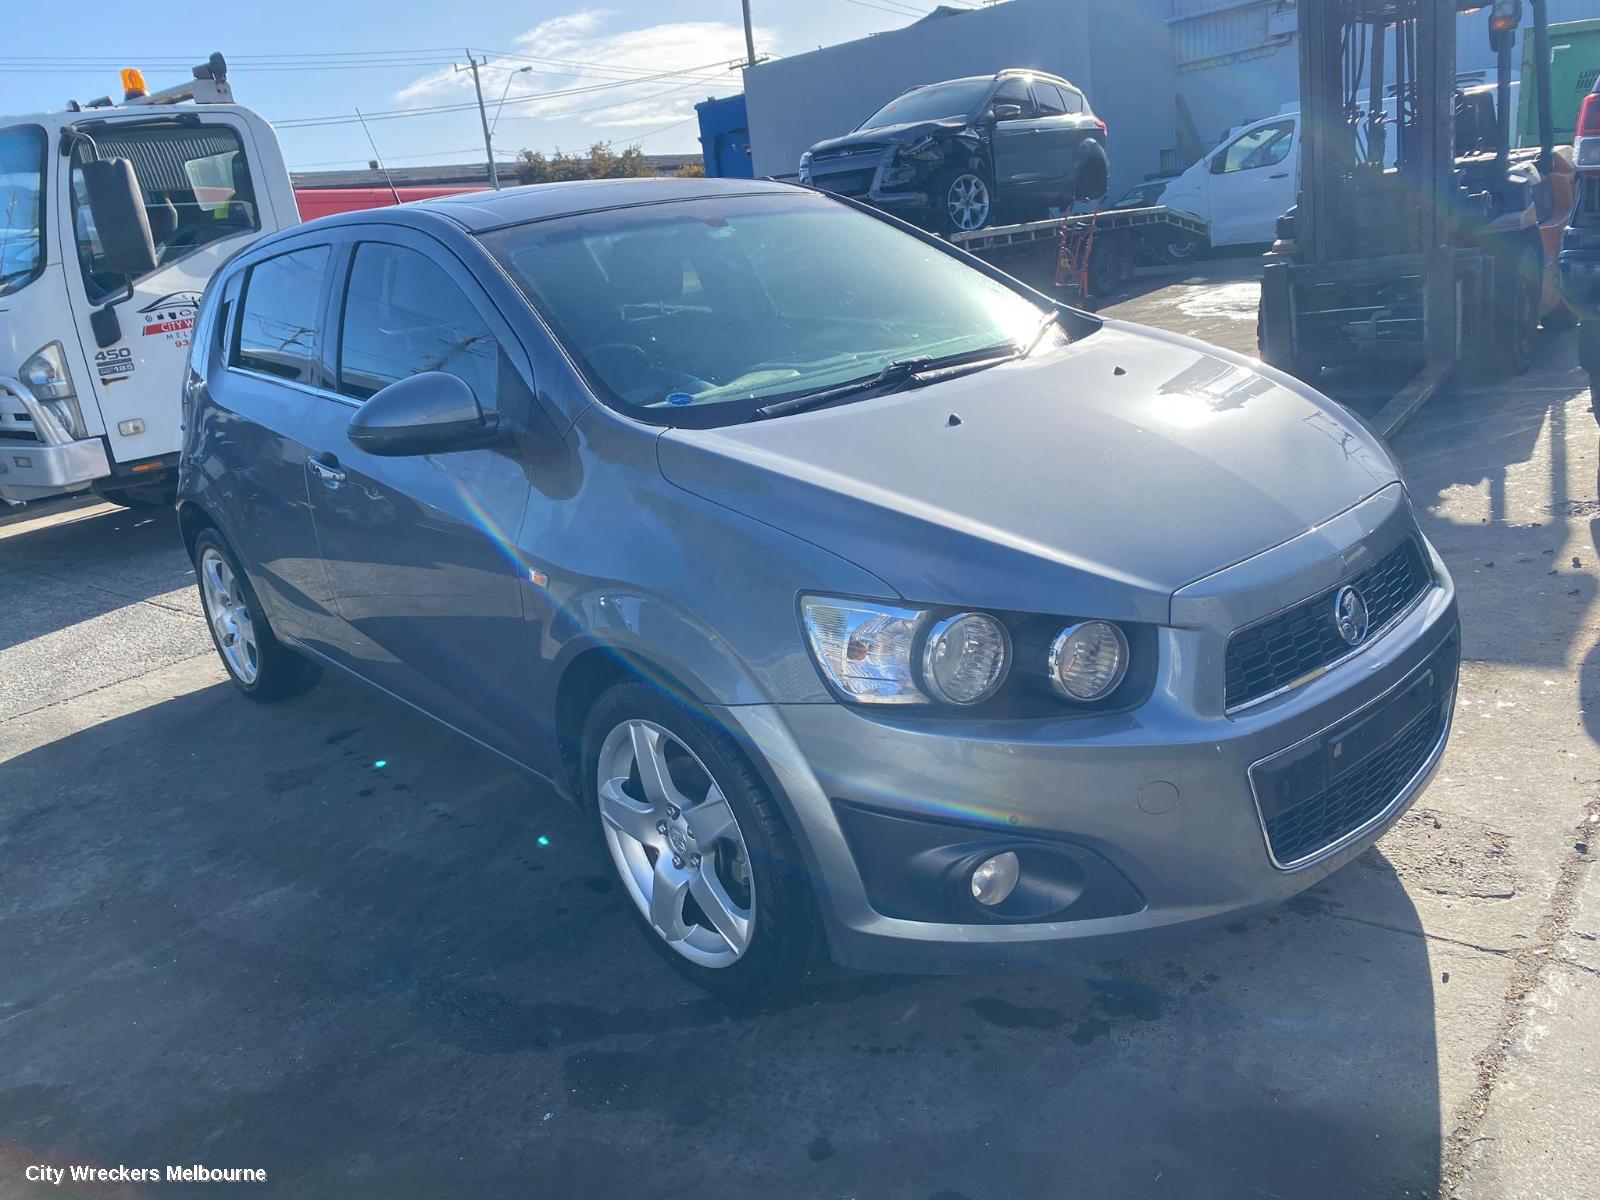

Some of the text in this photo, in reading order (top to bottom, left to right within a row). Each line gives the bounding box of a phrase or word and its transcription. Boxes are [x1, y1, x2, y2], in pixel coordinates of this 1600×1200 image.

[161, 320, 182, 332] CITY
[166, 331, 188, 340] MEL
[174, 339, 190, 348] 93
[95, 348, 131, 361] 450
